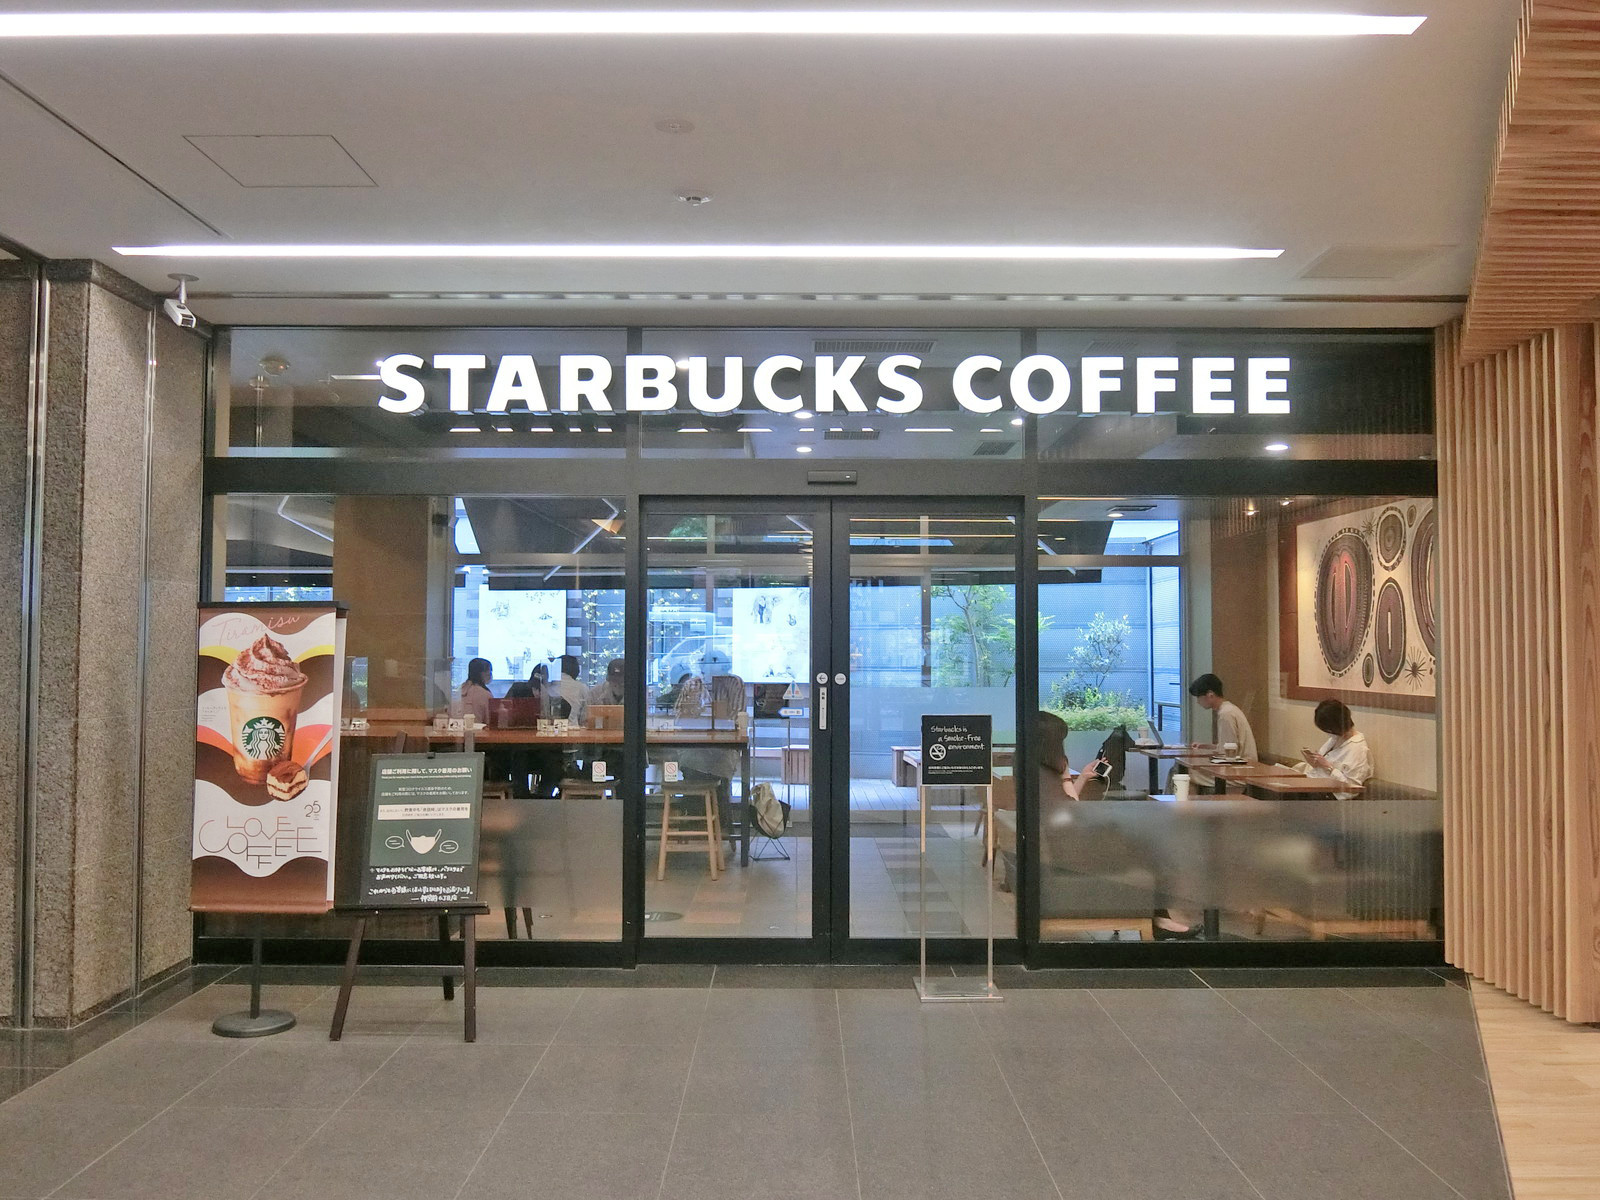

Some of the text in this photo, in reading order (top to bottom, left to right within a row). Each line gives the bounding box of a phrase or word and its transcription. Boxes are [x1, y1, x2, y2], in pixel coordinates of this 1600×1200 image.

[378, 354, 1291, 414] STARBUCKS COFFEE
[227, 815, 295, 840] LOVE
[304, 801, 321, 817] 25
[199, 819, 322, 870] COFFEE
